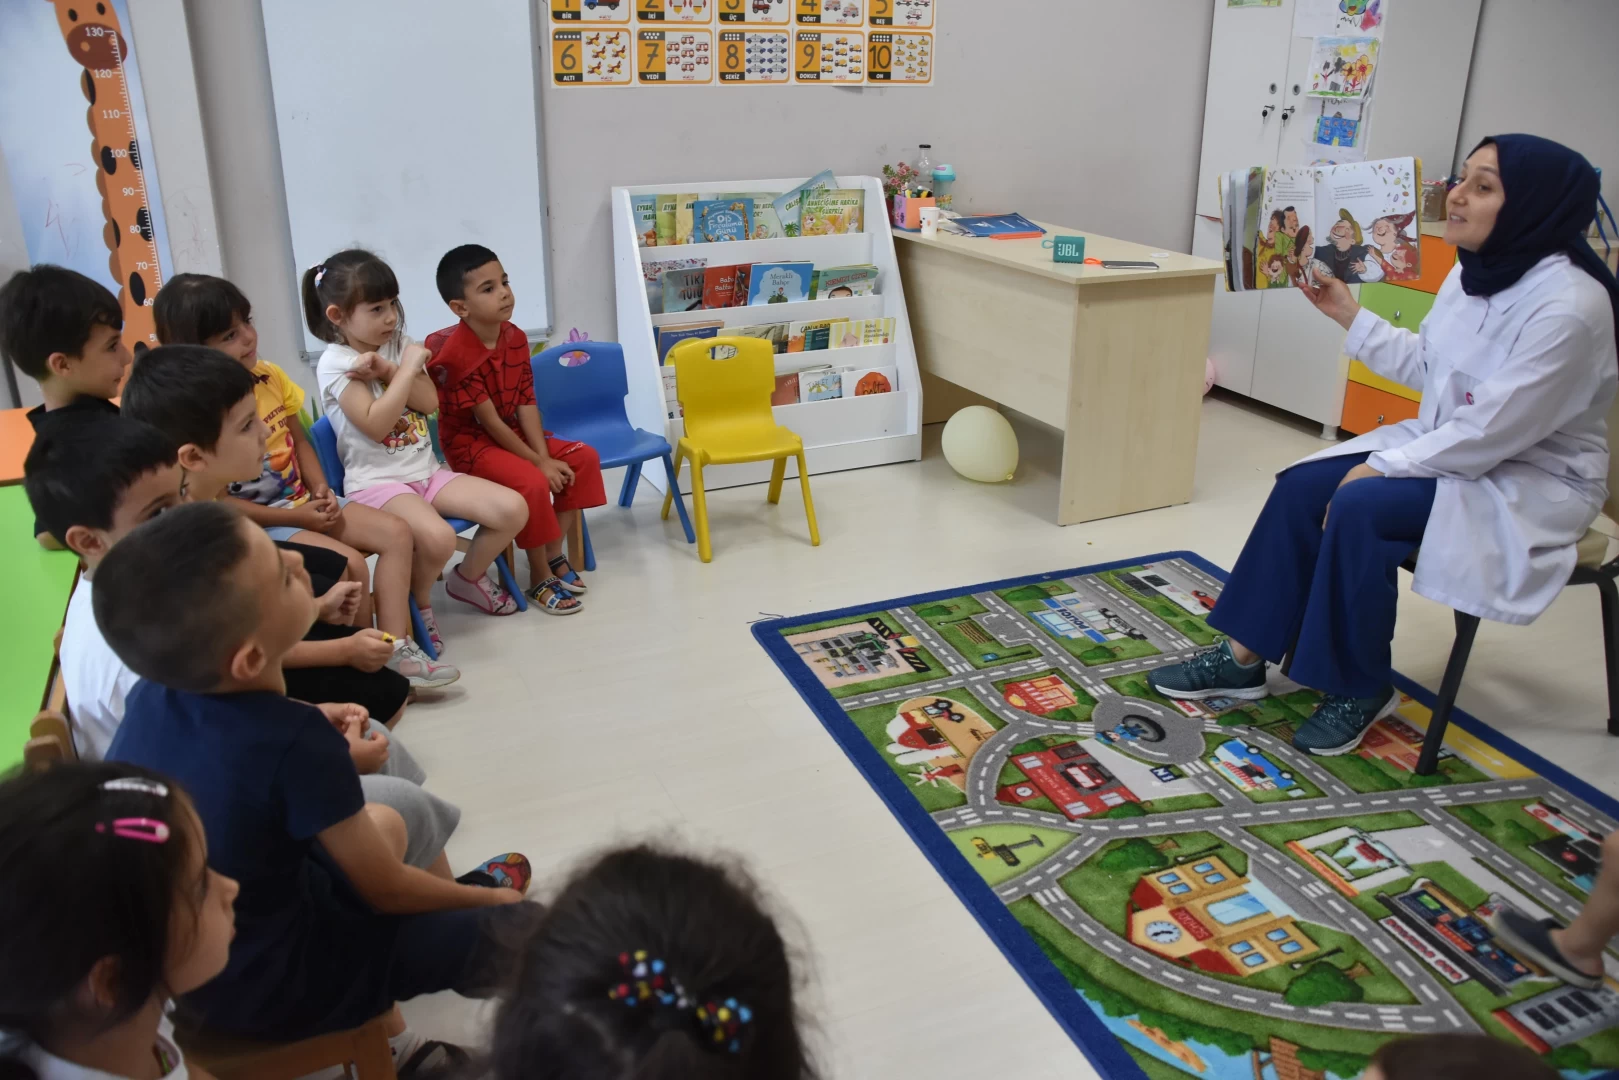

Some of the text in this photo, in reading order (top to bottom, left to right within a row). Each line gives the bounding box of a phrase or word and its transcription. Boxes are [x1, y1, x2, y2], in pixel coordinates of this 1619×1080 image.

[729, 13, 737, 21] ÜÇ
[85, 27, 104, 37] 130
[560, 44, 576, 70] 6
[644, 43, 660, 70] 7
[726, 44, 740, 70] 8
[802, 44, 815, 69] 9
[869, 45, 891, 70] 10
[94, 69, 112, 79] 120
[102, 109, 120, 119] 110
[110, 148, 128, 158] 100
[122, 187, 135, 196] 90
[129, 224, 142, 234] 80
[1058, 244, 1078, 256] JBL
[136, 262, 148, 271] 70
[143, 298, 154, 307] 60
[1056, 608, 1089, 630] POLICE
